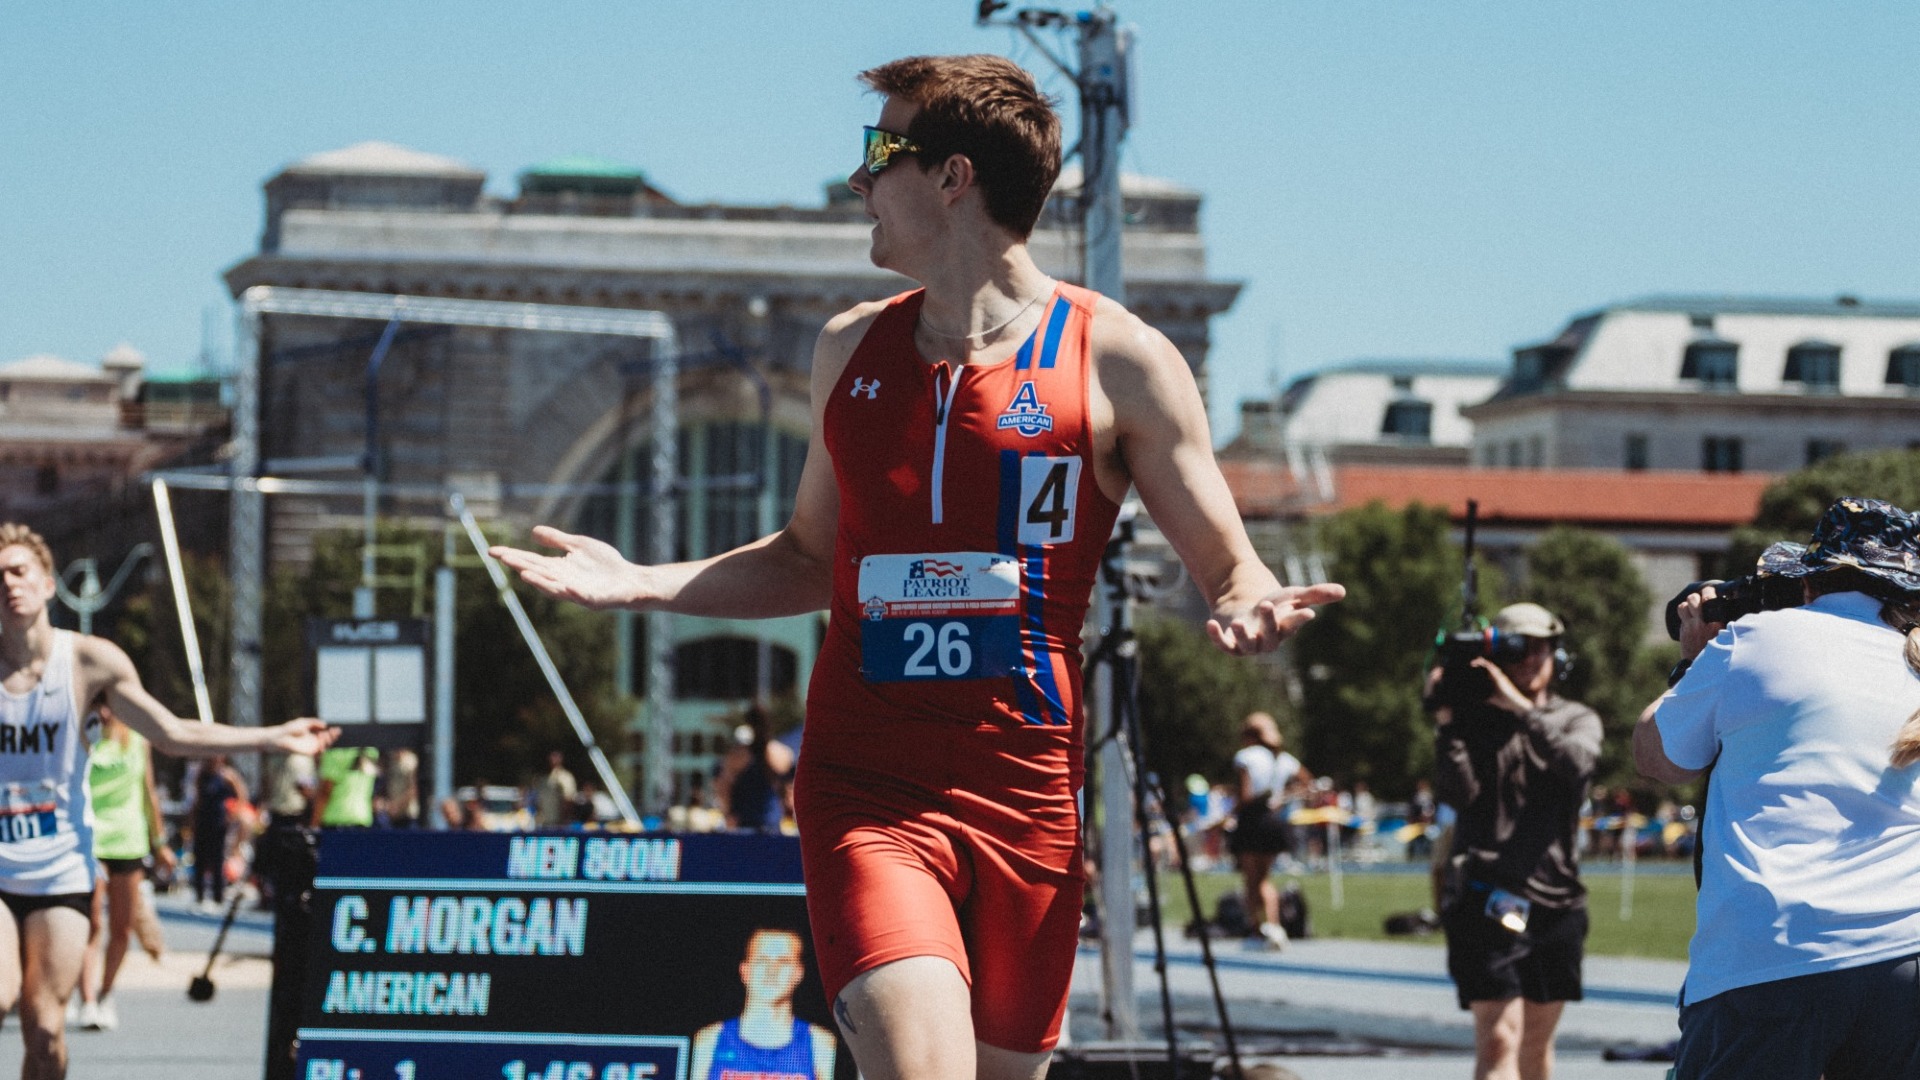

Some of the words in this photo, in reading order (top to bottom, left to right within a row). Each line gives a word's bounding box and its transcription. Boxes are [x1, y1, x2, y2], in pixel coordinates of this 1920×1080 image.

[1001, 414, 1050, 427] AMERICAN
[1026, 463, 1069, 538] 4
[903, 577, 970, 589] PATRIOT
[903, 587, 970, 598] LEAGUE
[903, 621, 972, 676] 26
[0, 722, 59, 753] RMY
[507, 836, 579, 879] MEN
[583, 838, 682, 881] 800M
[332, 895, 377, 953] C.
[385, 895, 588, 956] MORGAN
[322, 970, 491, 1016] AMERICAN
